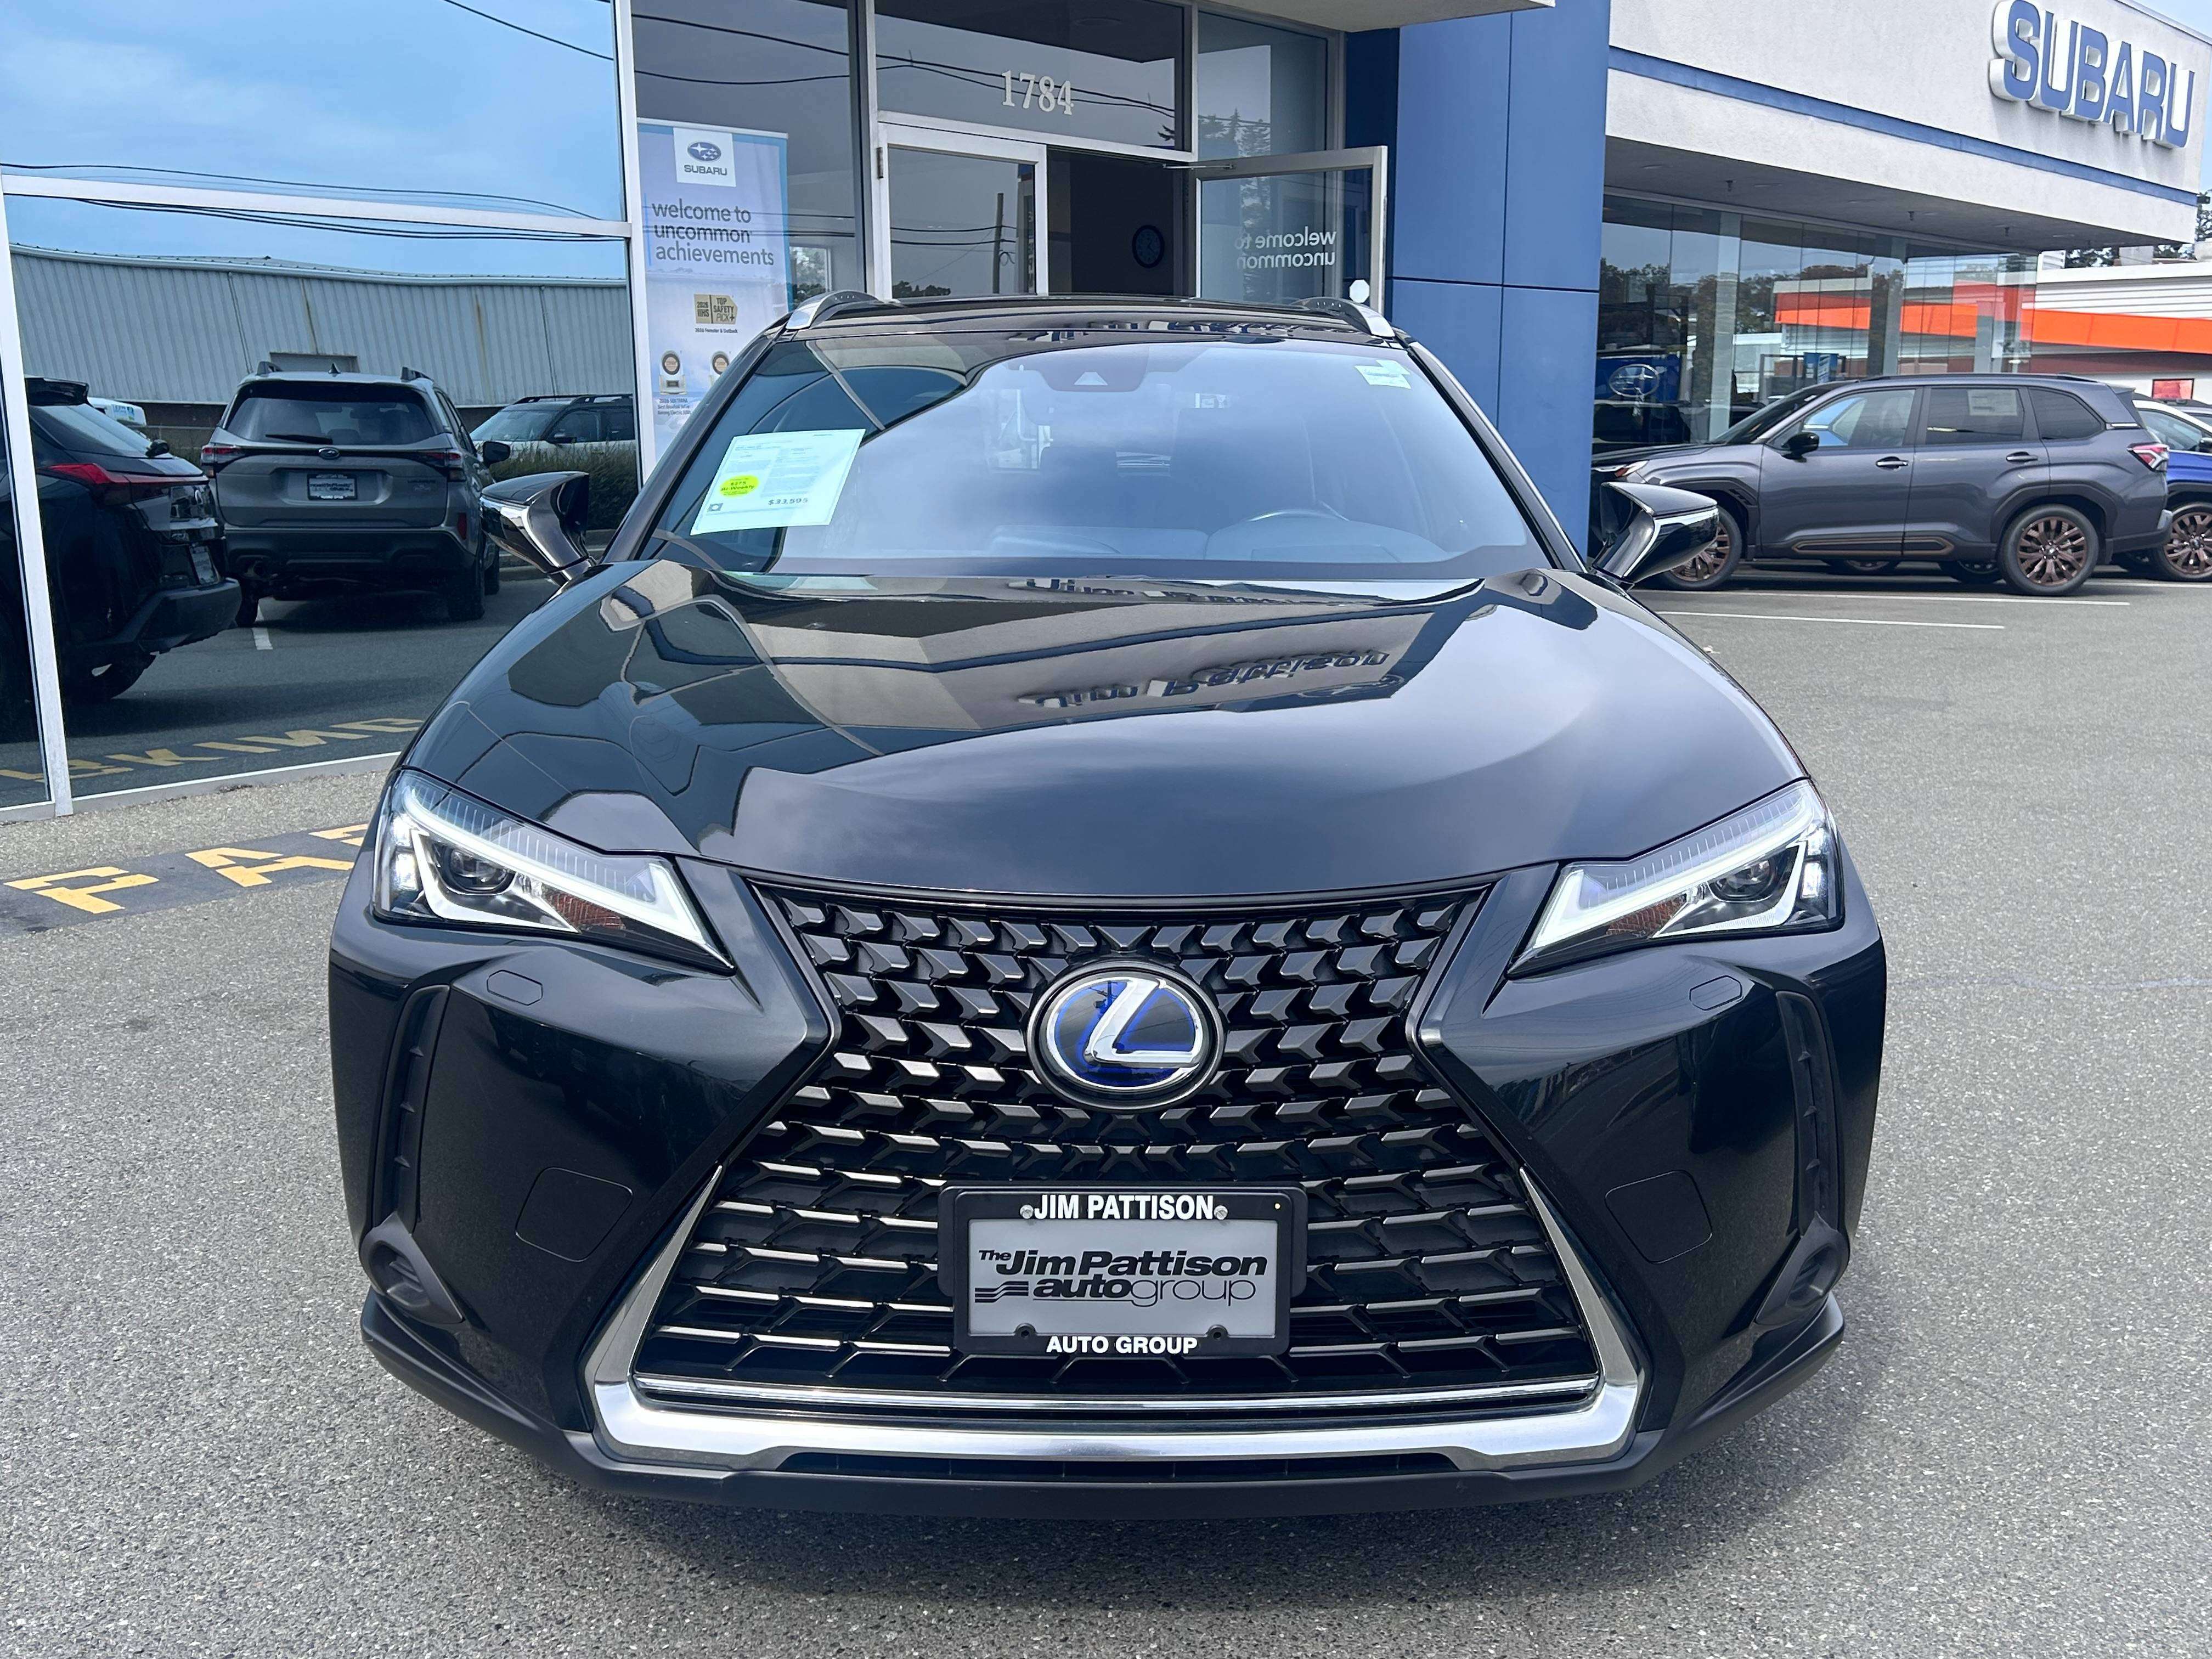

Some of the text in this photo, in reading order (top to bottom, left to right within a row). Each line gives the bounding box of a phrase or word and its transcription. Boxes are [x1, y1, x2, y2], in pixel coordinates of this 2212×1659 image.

[1989, 0, 2195, 148] SUBARU
[1001, 70, 1074, 115] 1784
[684, 165, 727, 176] SUBARU
[652, 198, 752, 223] welcome to
[654, 224, 750, 243] uncommon
[656, 240, 774, 266] achievements
[713, 305, 734, 313] SAFETY
[1034, 1194, 1214, 1220] JIM PATTISON
[978, 1250, 1268, 1276] The Jim Pattison
[1046, 1335, 1198, 1355] AUTO GROUP
